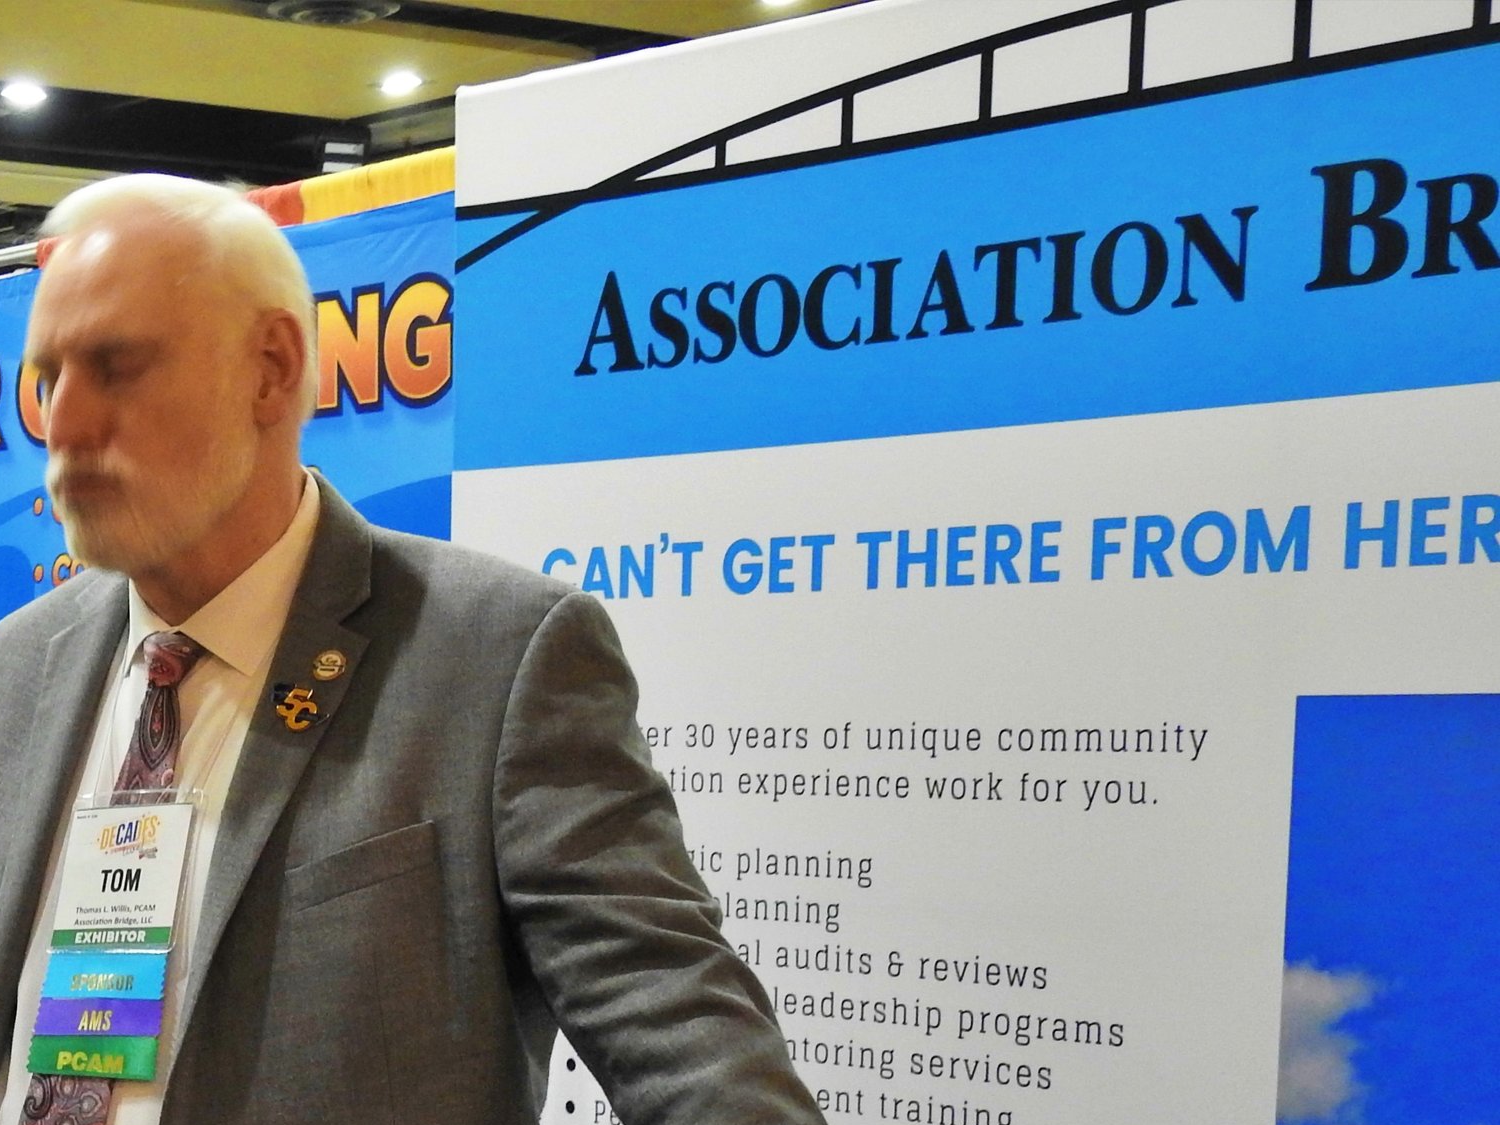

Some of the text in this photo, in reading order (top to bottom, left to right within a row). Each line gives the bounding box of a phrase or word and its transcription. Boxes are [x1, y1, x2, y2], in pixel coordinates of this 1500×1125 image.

[575, 157, 1500, 377] ASSOCIATION BR
[723, 534, 835, 596] GET
[856, 520, 1062, 590] THERE
[1091, 505, 1310, 581] FROM
[1343, 494, 1500, 570] HER
[642, 721, 1208, 761] er 30 years of unique community
[738, 768, 911, 803] experience
[926, 771, 1003, 802] work
[1019, 771, 1067, 804] for
[1083, 777, 1159, 812] you.
[101, 868, 142, 893] TOM
[737, 848, 873, 888] planning
[73, 918, 113, 927] Association
[140, 916, 153, 924] LLC
[75, 905, 102, 915] Thomas
[133, 903, 157, 912] PCAM
[717, 891, 840, 933] lanning
[74, 930, 147, 944] EXHIBITOR
[776, 945, 873, 975] audits
[887, 950, 905, 978] &
[918, 955, 1049, 991] reviews
[77, 1008, 113, 1032] AMS
[773, 986, 1126, 1048] leadership programs
[56, 1051, 125, 1075] PCAM
[910, 1051, 1052, 1091] services
[816, 1088, 864, 1116] ent
